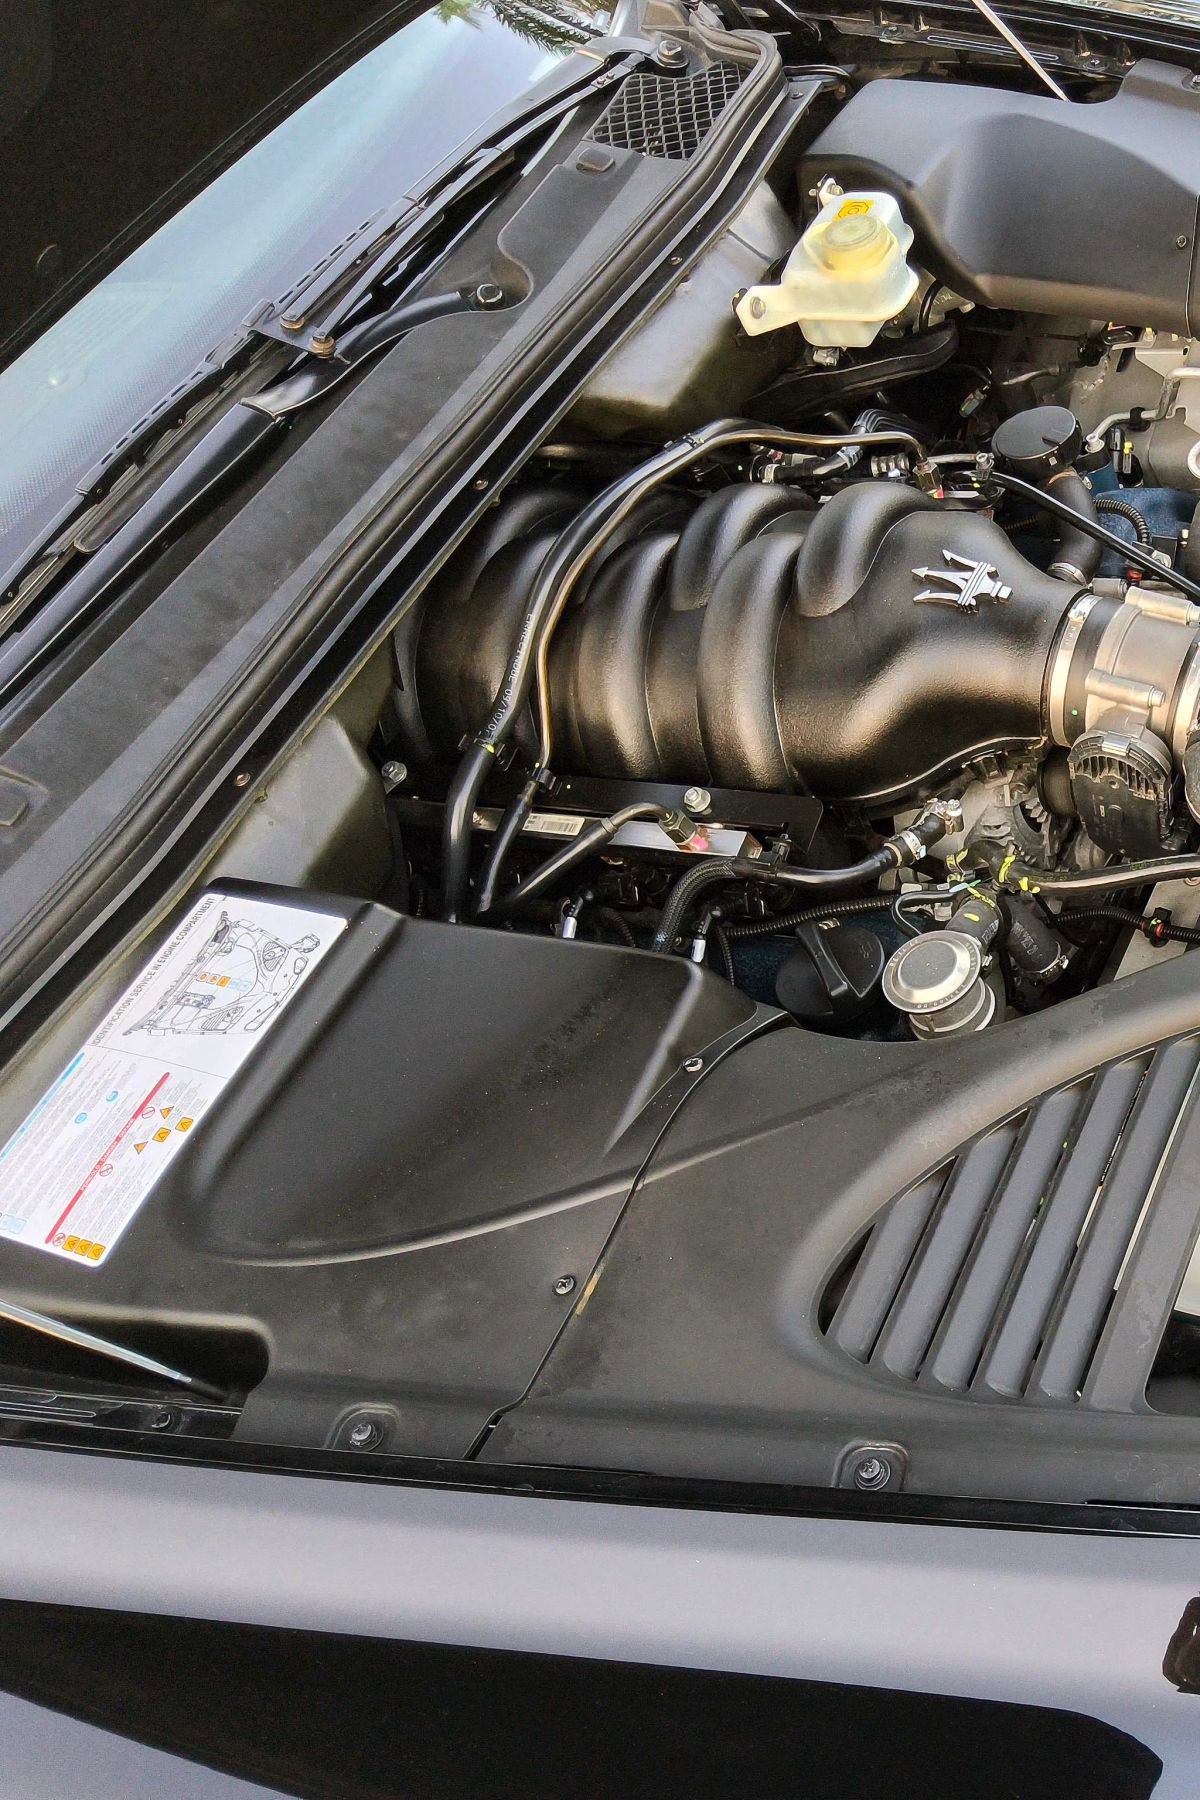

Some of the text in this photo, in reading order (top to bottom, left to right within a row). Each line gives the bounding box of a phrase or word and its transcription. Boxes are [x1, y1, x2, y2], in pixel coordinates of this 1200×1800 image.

[91, 996, 135, 1046] IDENTIFICATION
[130, 971, 154, 997] SERVICE
[160, 940, 181, 967] ENGINE
[176, 897, 216, 942] COMPARTMENT
